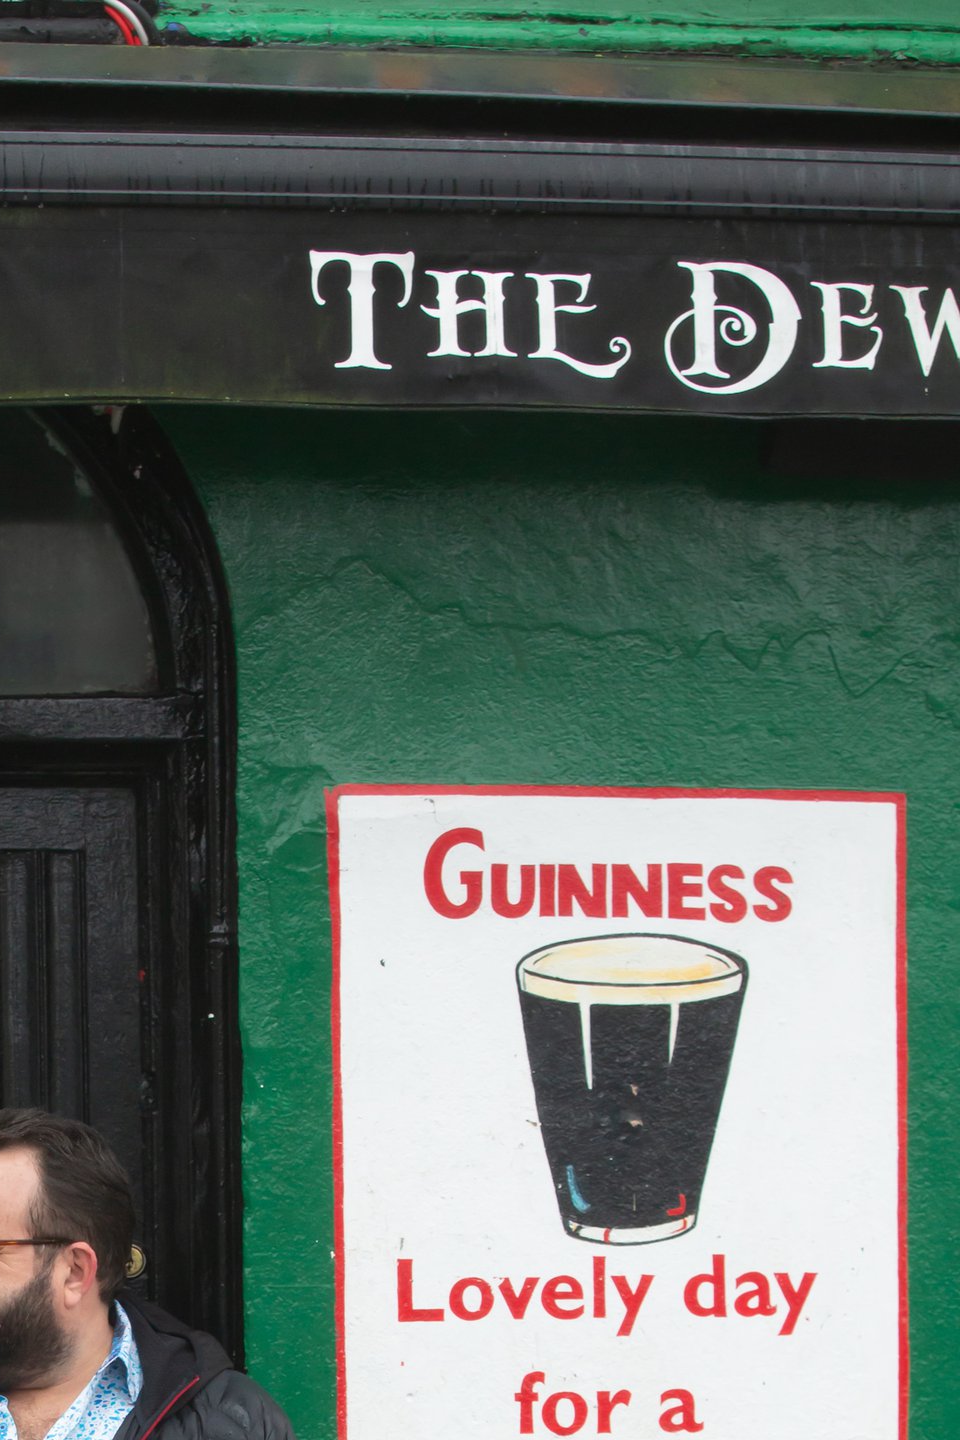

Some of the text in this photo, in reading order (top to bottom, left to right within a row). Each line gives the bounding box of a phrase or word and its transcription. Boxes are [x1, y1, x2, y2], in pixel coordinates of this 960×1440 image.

[309, 249, 632, 378] THE
[423, 827, 794, 924] GUINNESS
[396, 1253, 818, 1336] Lovely day
[514, 1371, 705, 1436] for a
